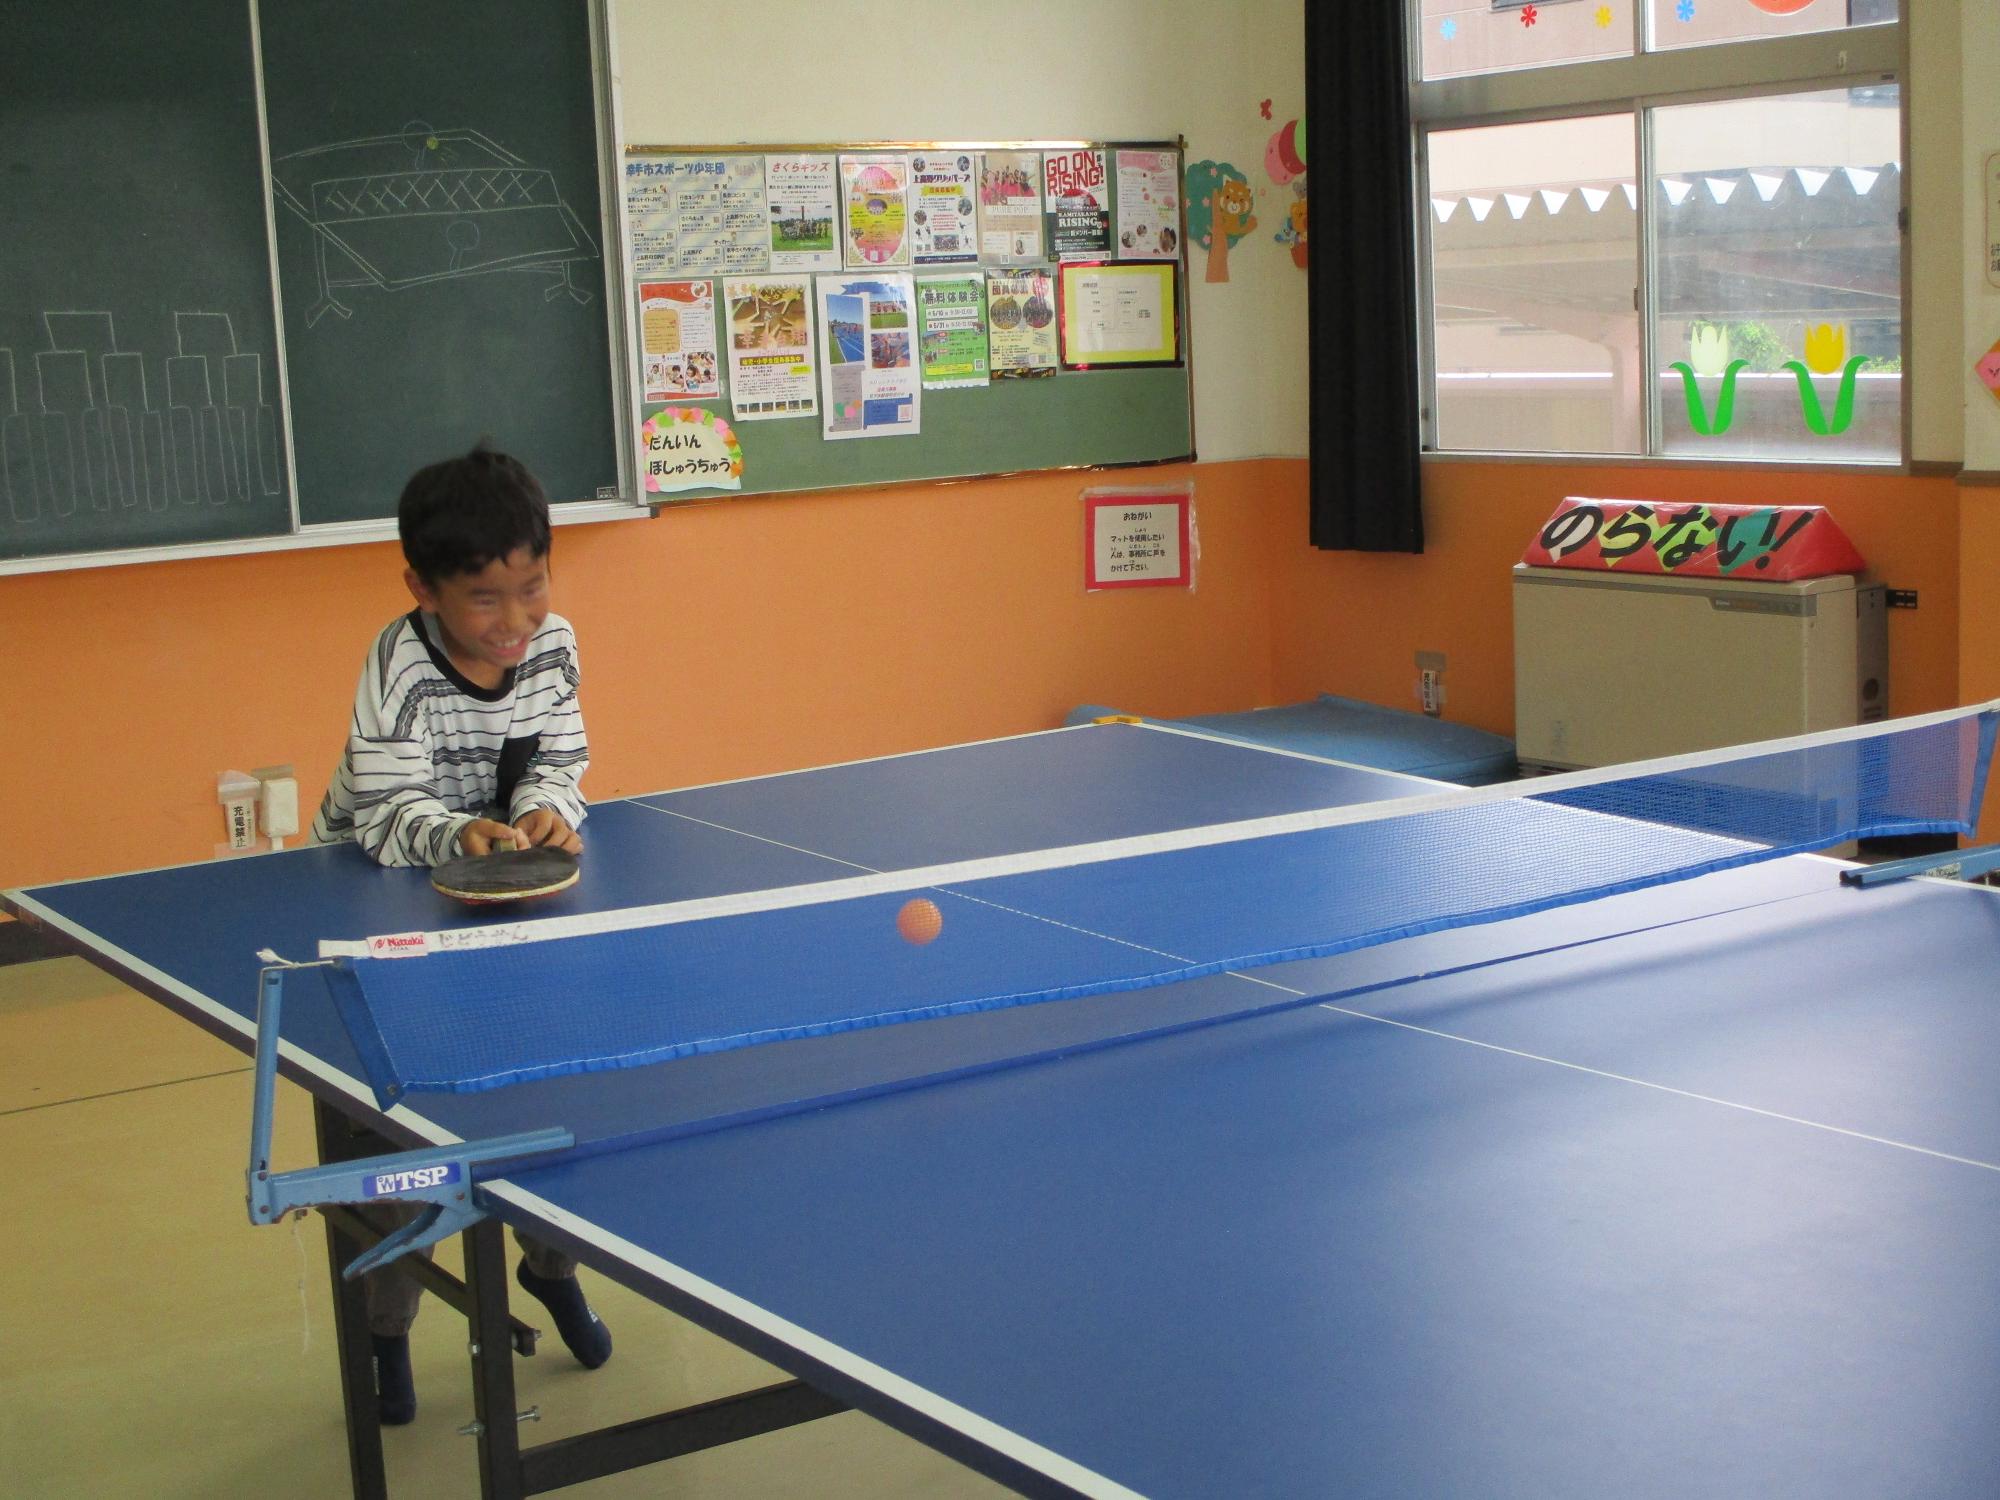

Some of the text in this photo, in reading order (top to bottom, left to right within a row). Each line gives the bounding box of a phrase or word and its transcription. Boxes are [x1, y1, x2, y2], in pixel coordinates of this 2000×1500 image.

[626, 162, 726, 177] 幸手市スポーツ少年団
[772, 162, 831, 174] さくらキッズ
[1046, 156, 1068, 179] GO
[1072, 151, 1096, 172] ON
[1047, 165, 1105, 197] RISING!
[1058, 217, 1099, 228] RISING
[649, 434, 702, 451] だんいん
[1123, 511, 1153, 521] おねがい
[1110, 534, 1165, 543] マットを使用したい
[233, 806, 247, 848] 充電禁止
[387, 935, 425, 946] Nittaku
[396, 1166, 448, 1191] TSP
